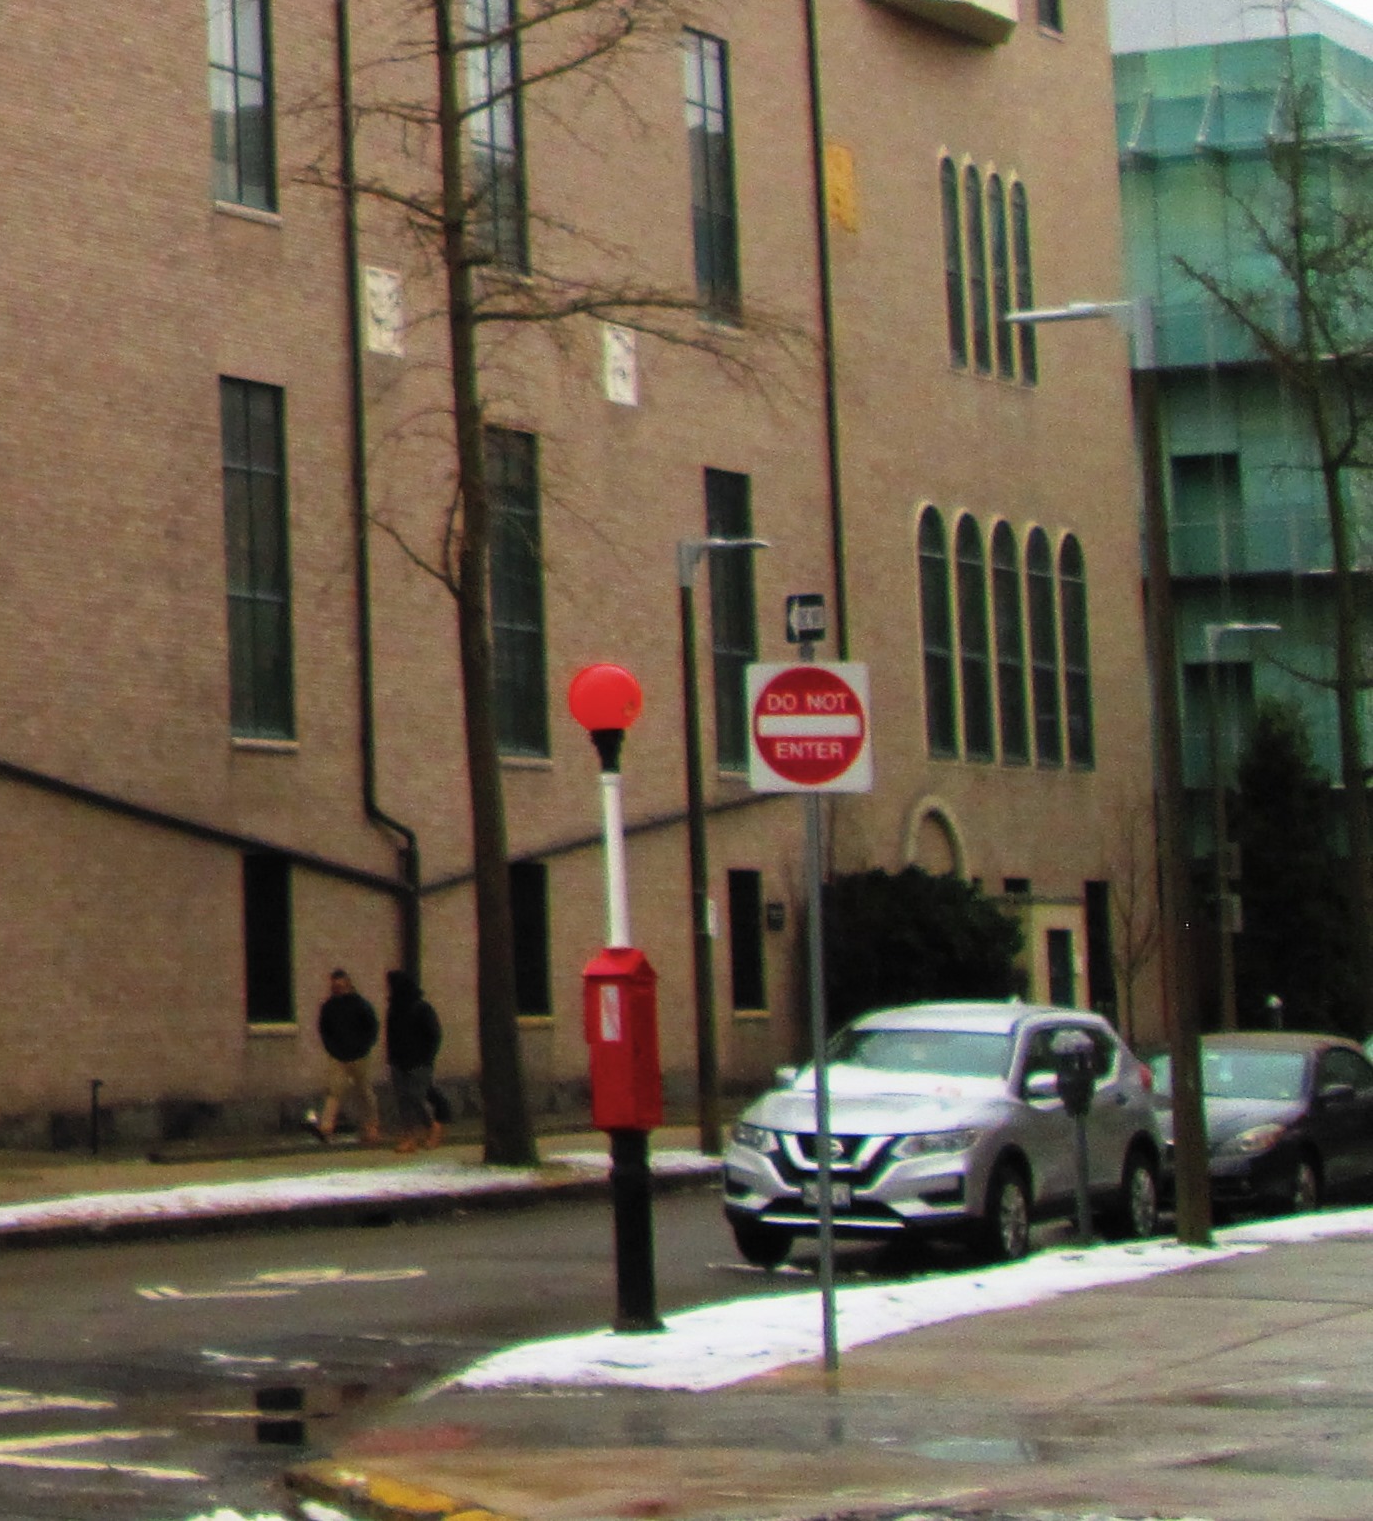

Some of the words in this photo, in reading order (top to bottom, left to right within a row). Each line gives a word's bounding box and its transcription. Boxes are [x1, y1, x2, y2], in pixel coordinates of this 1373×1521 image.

[767, 693, 797, 711] DO
[806, 692, 848, 711] NOT
[776, 742, 844, 759] ENTER
